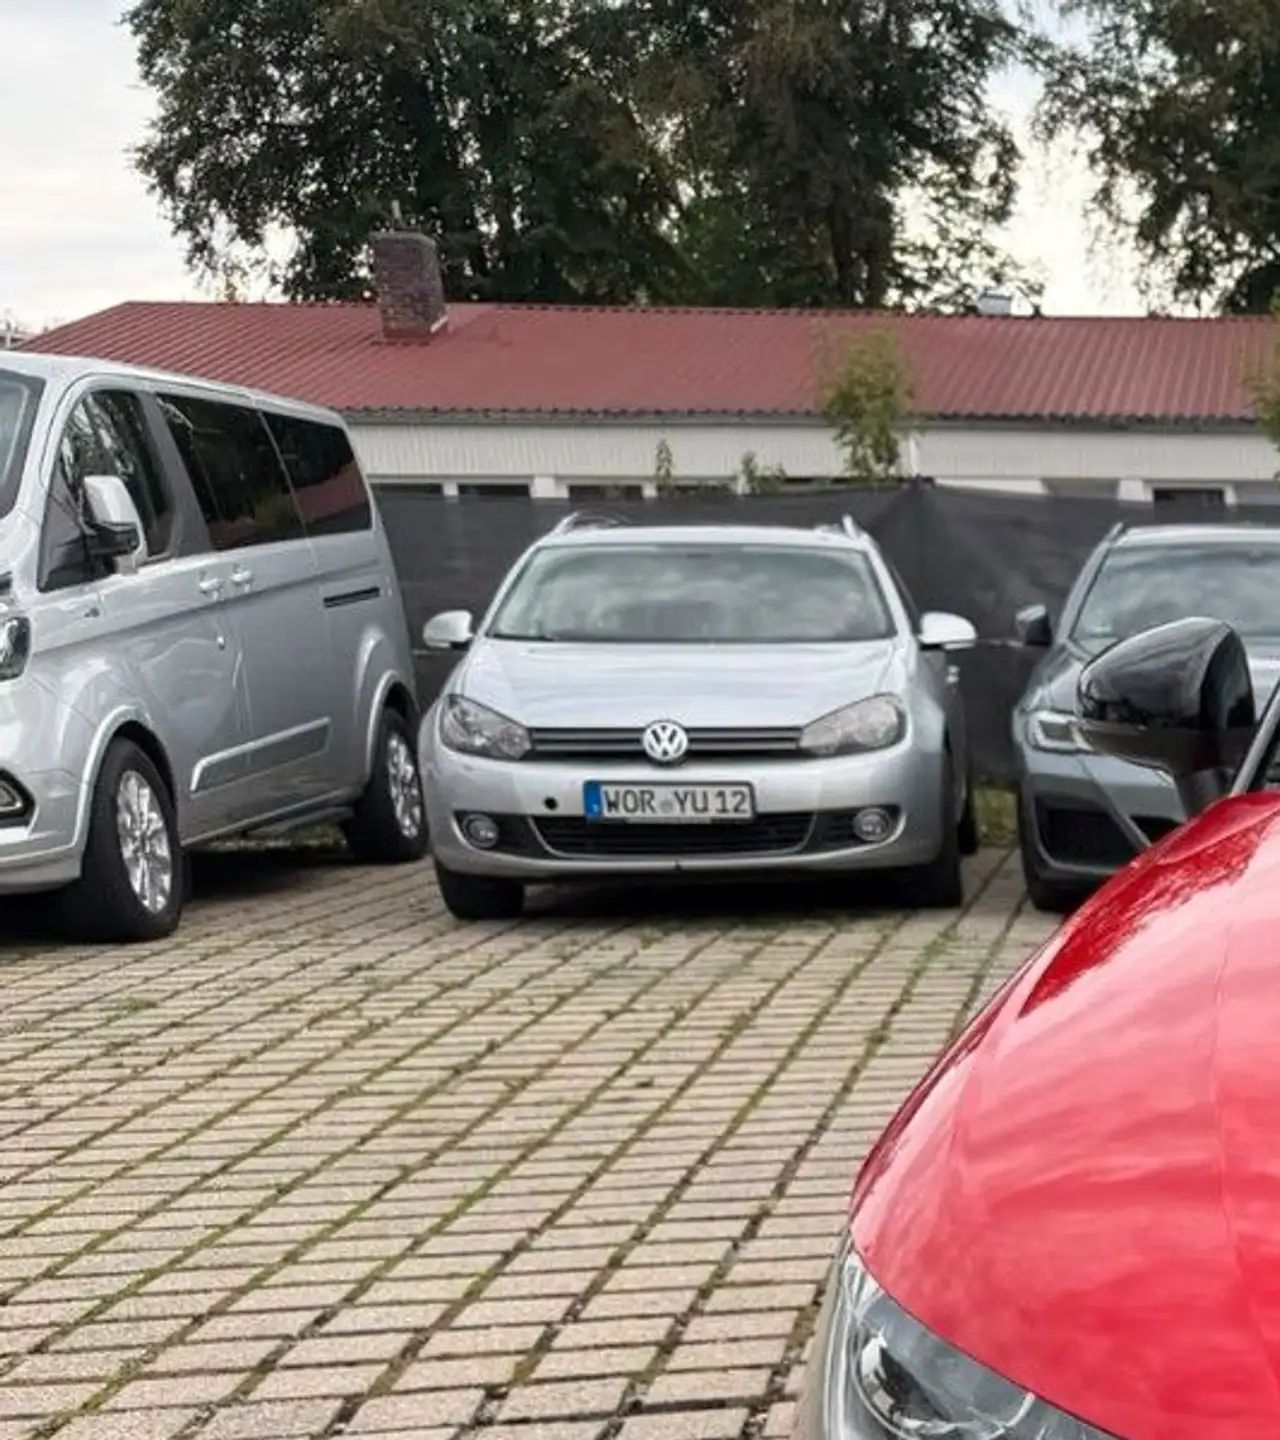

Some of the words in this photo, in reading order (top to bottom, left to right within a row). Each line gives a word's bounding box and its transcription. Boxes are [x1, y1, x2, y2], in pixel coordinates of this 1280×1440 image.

[604, 789, 656, 814] WOR
[673, 789, 709, 814] YU
[714, 789, 748, 815] 12
